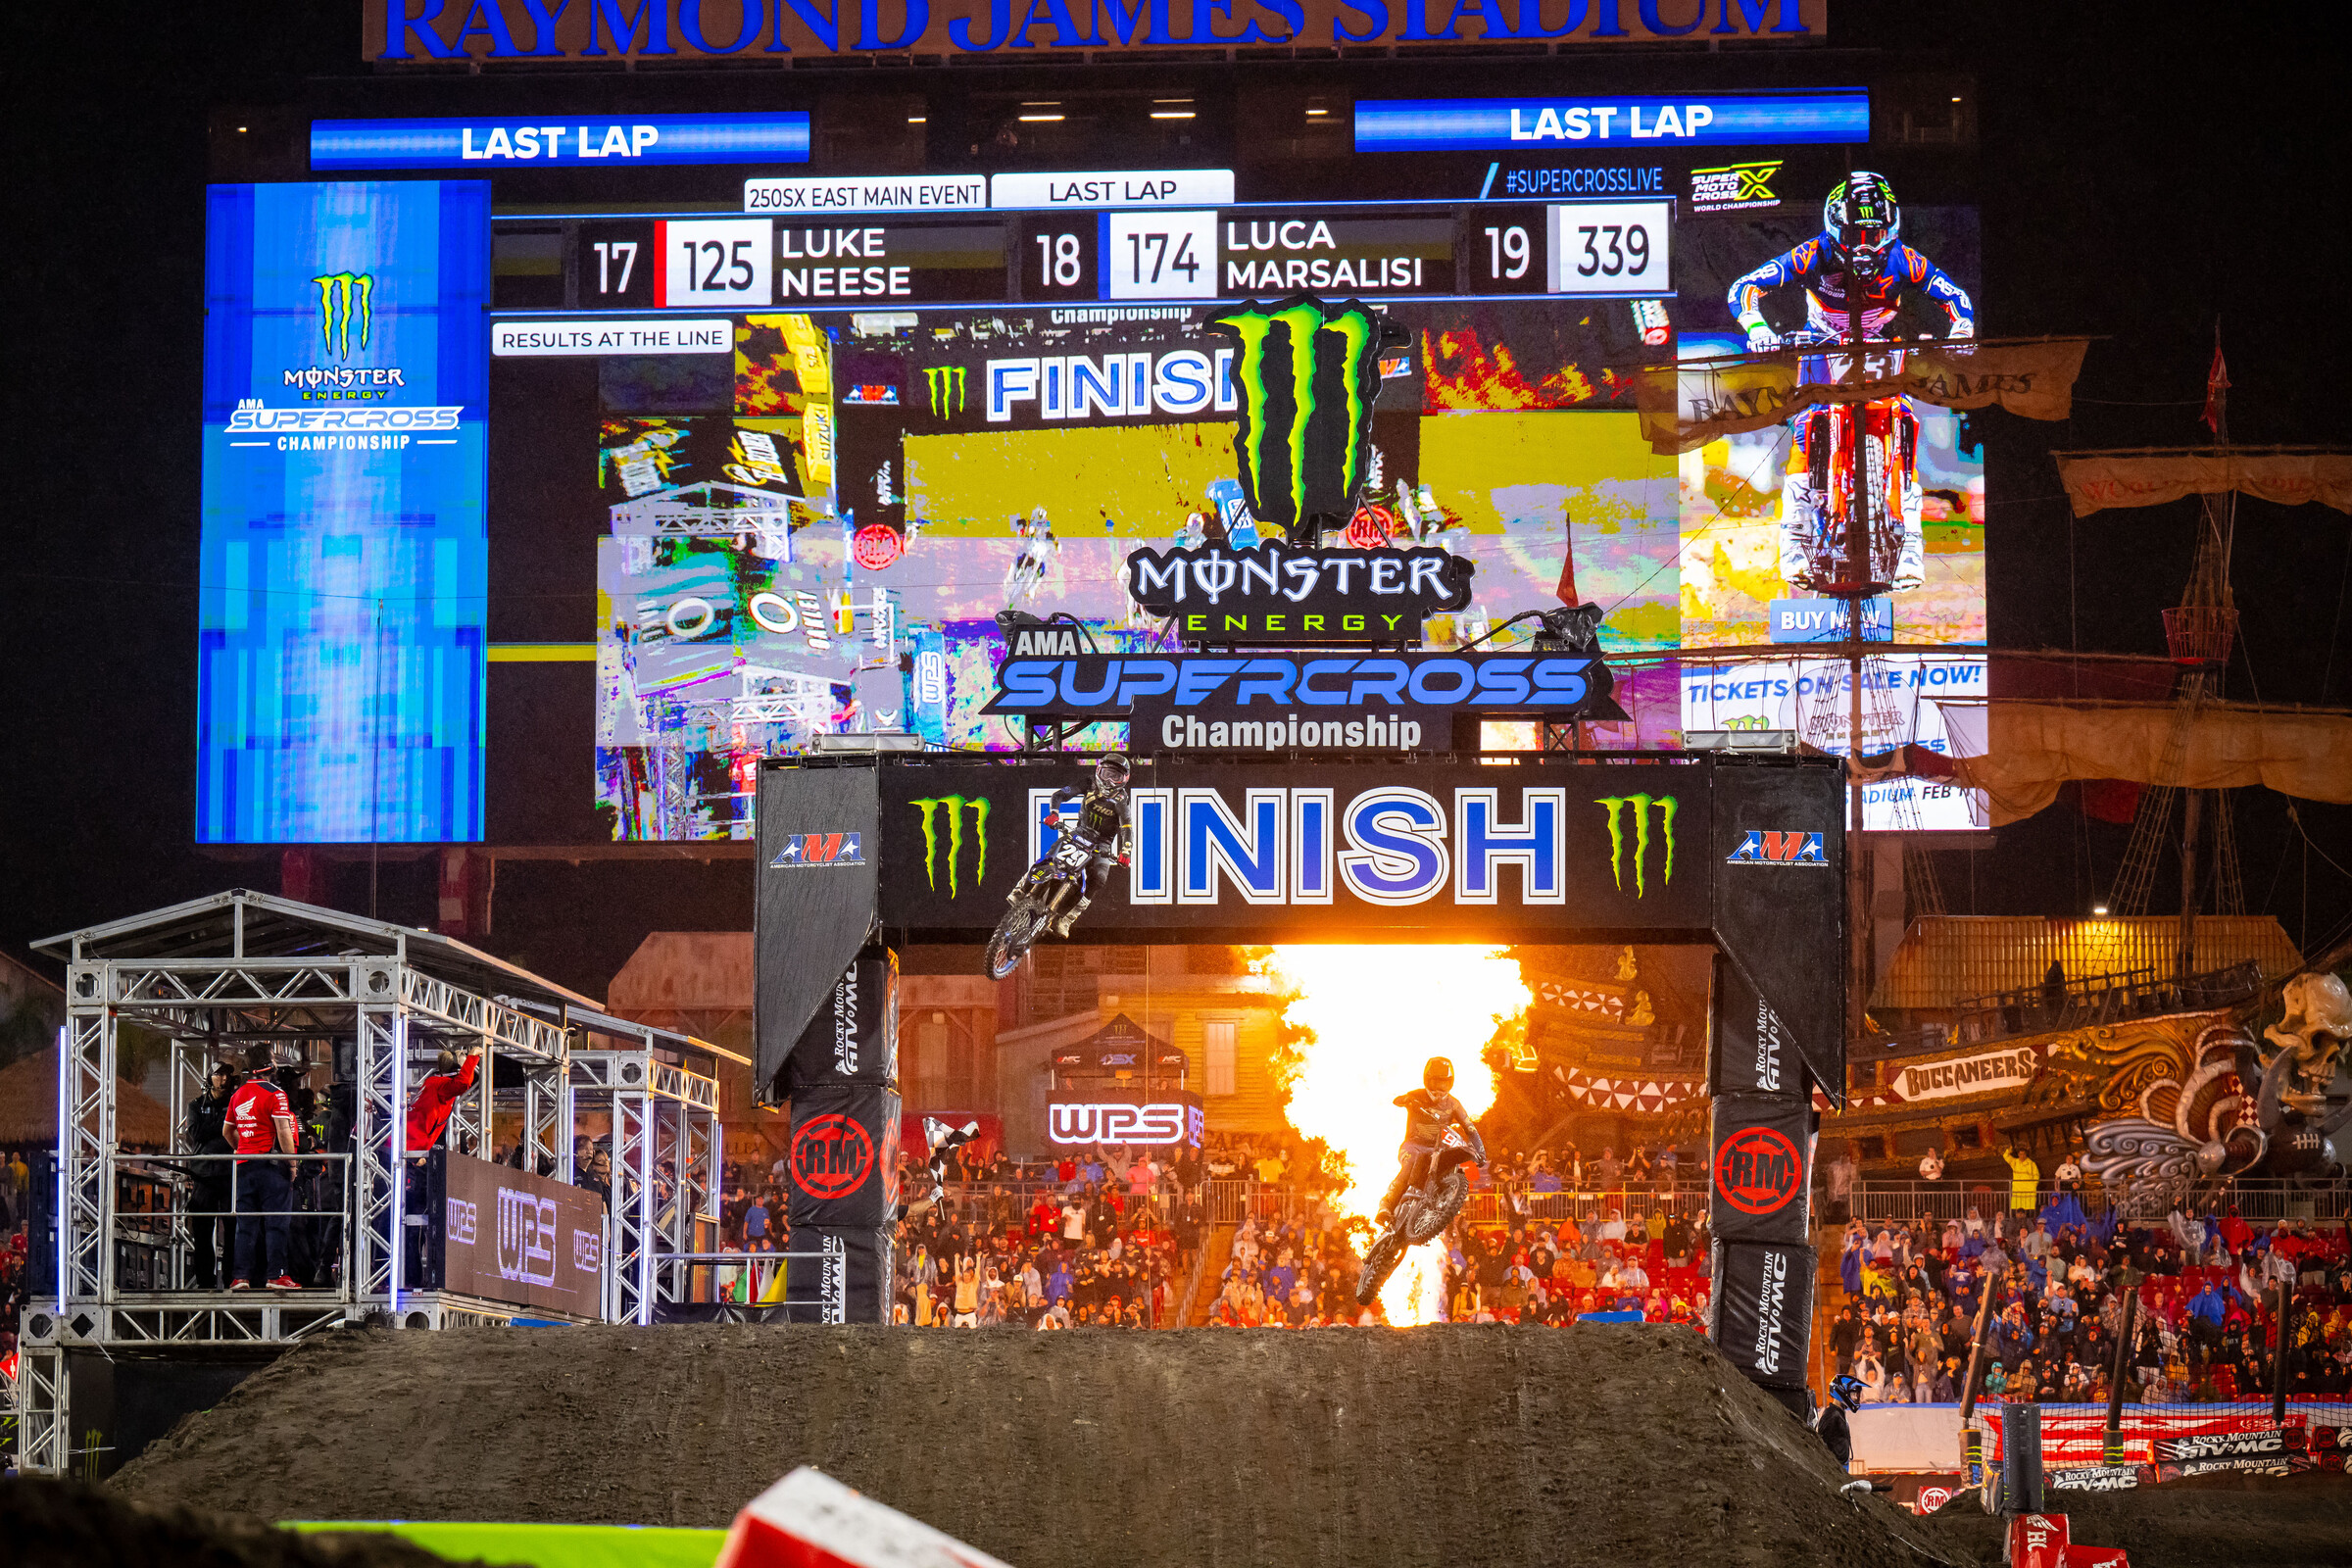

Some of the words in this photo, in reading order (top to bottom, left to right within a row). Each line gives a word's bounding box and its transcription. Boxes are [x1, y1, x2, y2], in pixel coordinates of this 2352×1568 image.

[377, 0, 931, 60] RAYMOND
[949, 0, 1305, 51] JAMES
[1509, 106, 1620, 143] LAST
[1629, 104, 1713, 138] LAP
[461, 126, 574, 162] LAST
[577, 124, 659, 159] LAP
[1049, 179, 1119, 203] LAST
[1128, 178, 1176, 202] LAP
[1506, 167, 1663, 195] #SUPERCROSSLIVE
[1690, 172, 1740, 185] SUPER
[1694, 181, 1739, 193] MOTO
[750, 184, 804, 208] 250SX
[809, 183, 859, 207] EAST
[864, 183, 915, 206] MAIN
[920, 182, 982, 206] EVENT
[1691, 190, 1740, 202] CROSS
[1693, 203, 1721, 213] WORLD
[1722, 199, 1782, 211] CHAMPIONSHIP
[593, 241, 637, 295] 17
[685, 239, 755, 293] 125
[783, 227, 887, 259] LUKE
[1036, 232, 1081, 288] 18
[1126, 230, 1200, 285] 174
[1227, 220, 1336, 252] LUCA
[1485, 226, 1531, 278] 19
[1577, 223, 1650, 277] 339
[783, 267, 912, 298] NEESE
[1227, 257, 1423, 291] MARSALISI
[1051, 307, 1193, 325] Championship
[501, 330, 594, 350] RESULTS
[598, 330, 626, 347] AT
[629, 330, 670, 347] THE
[676, 329, 724, 347] LINE
[283, 366, 406, 389] MONSTER
[238, 398, 265, 410] AMA
[302, 390, 388, 401] ENERGY
[227, 409, 461, 430] SUPERCROSS
[277, 435, 411, 451] CHAMPIONSHIP
[1137, 548, 1454, 605] MONSTER
[1186, 613, 1403, 631] ENERGY
[1781, 611, 1824, 630] BUY
[1830, 609, 1882, 629] NW
[1014, 630, 1077, 656] AMA
[995, 659, 1592, 706] SUPERCROSS
[1689, 677, 1788, 704] TICKETS
[1910, 664, 1982, 687] NOW!
[1161, 713, 1422, 752] Championship
[1922, 785, 1951, 800] FEB
[769, 832, 866, 863] AMA
[1055, 842, 1089, 867] 29
[1726, 830, 1830, 861] AMA
[834, 1016, 845, 1057] ROCKY
[1755, 1034, 1767, 1074] ROCKY
[1905, 1049, 2034, 1100] BUCCANEERS
[1049, 1103, 1185, 1145] WPS
[806, 1137, 860, 1177] RM
[1732, 1150, 1788, 1193] RM
[447, 1197, 477, 1246] WPS
[497, 1186, 558, 1288] WPS
[573, 1228, 600, 1273] WPS
[1758, 1250, 1774, 1316] MOUNTAIN
[1755, 1316, 1769, 1355] ROCKY
[2191, 1432, 2226, 1445] ROCKY
[2226, 1429, 2282, 1443] MOUNTAIN
[2065, 1471, 2090, 1482] ROCKY
[2090, 1467, 2136, 1479] MOUNTAIN
[2198, 1460, 2232, 1471] ROCKY
[2232, 1457, 2289, 1470] MOUNTAIN
[1924, 1490, 1946, 1509] RM
